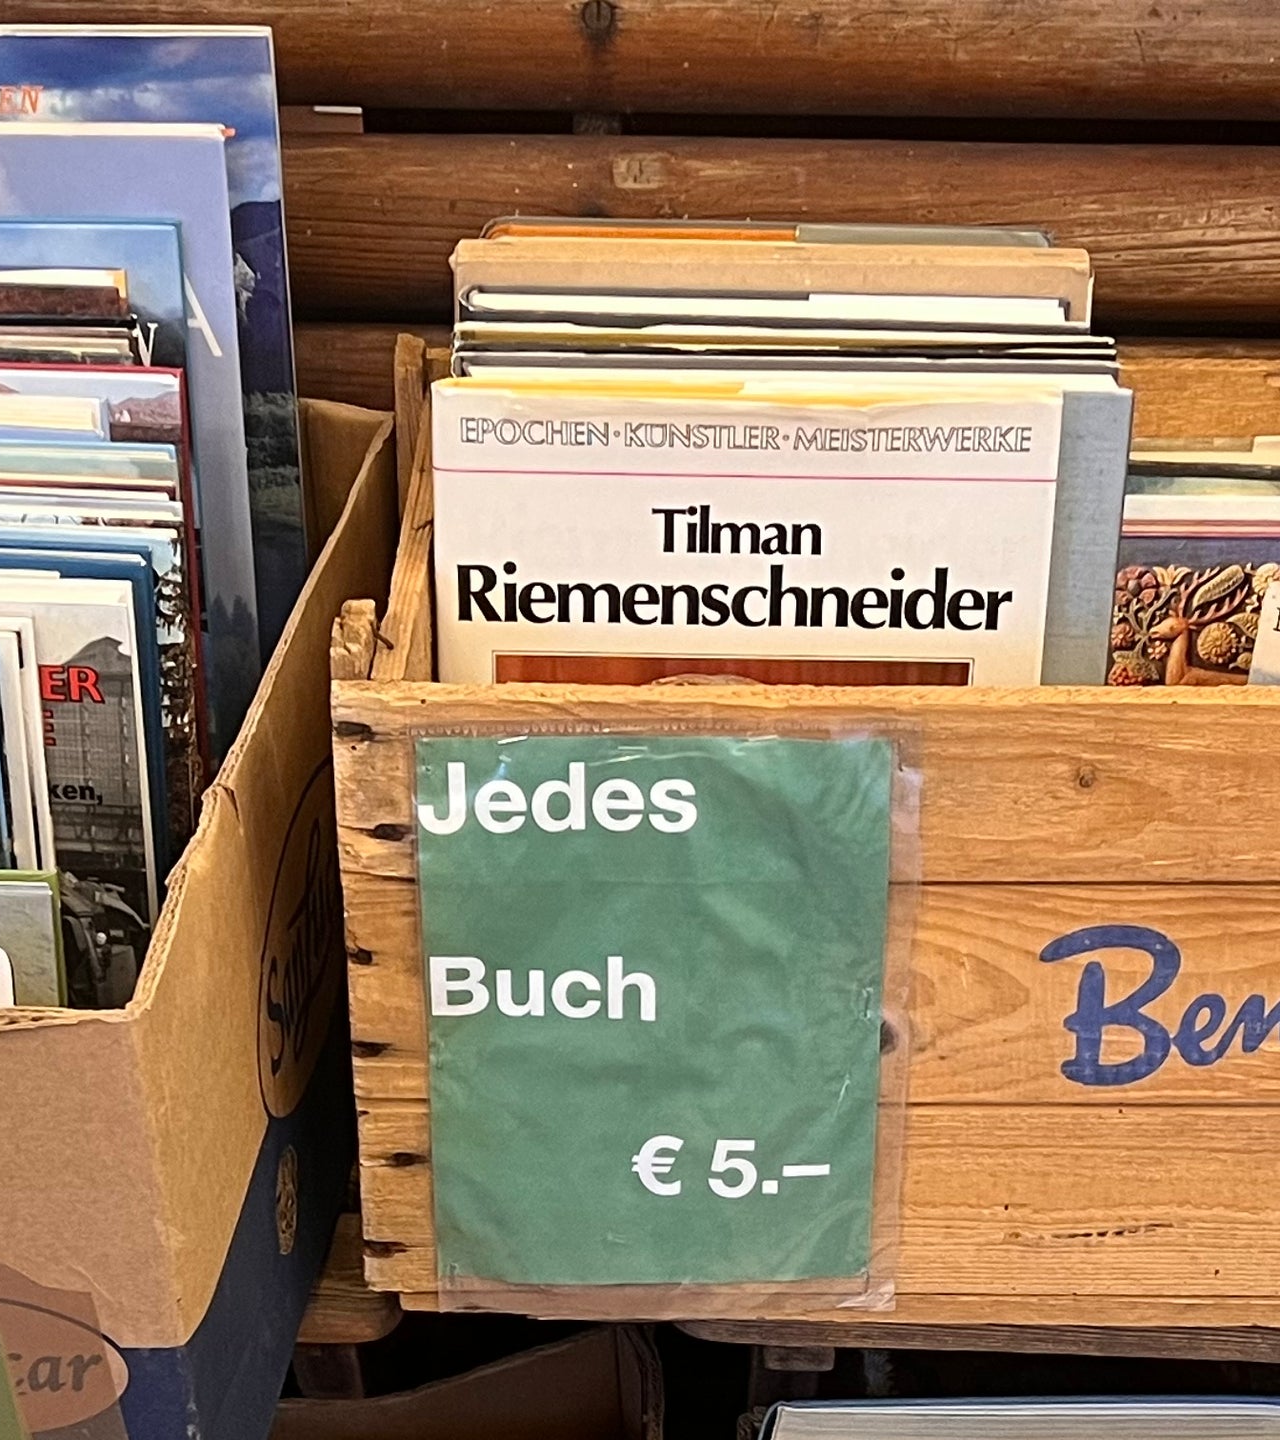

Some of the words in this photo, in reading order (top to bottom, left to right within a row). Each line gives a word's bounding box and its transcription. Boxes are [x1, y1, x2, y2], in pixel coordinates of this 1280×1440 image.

[652, 505, 822, 555] Tilman
[456, 562, 1013, 632] Riemenschneider
[418, 762, 697, 835] Jedes
[429, 956, 656, 1022] Buch
[631, 1136, 683, 1196] €
